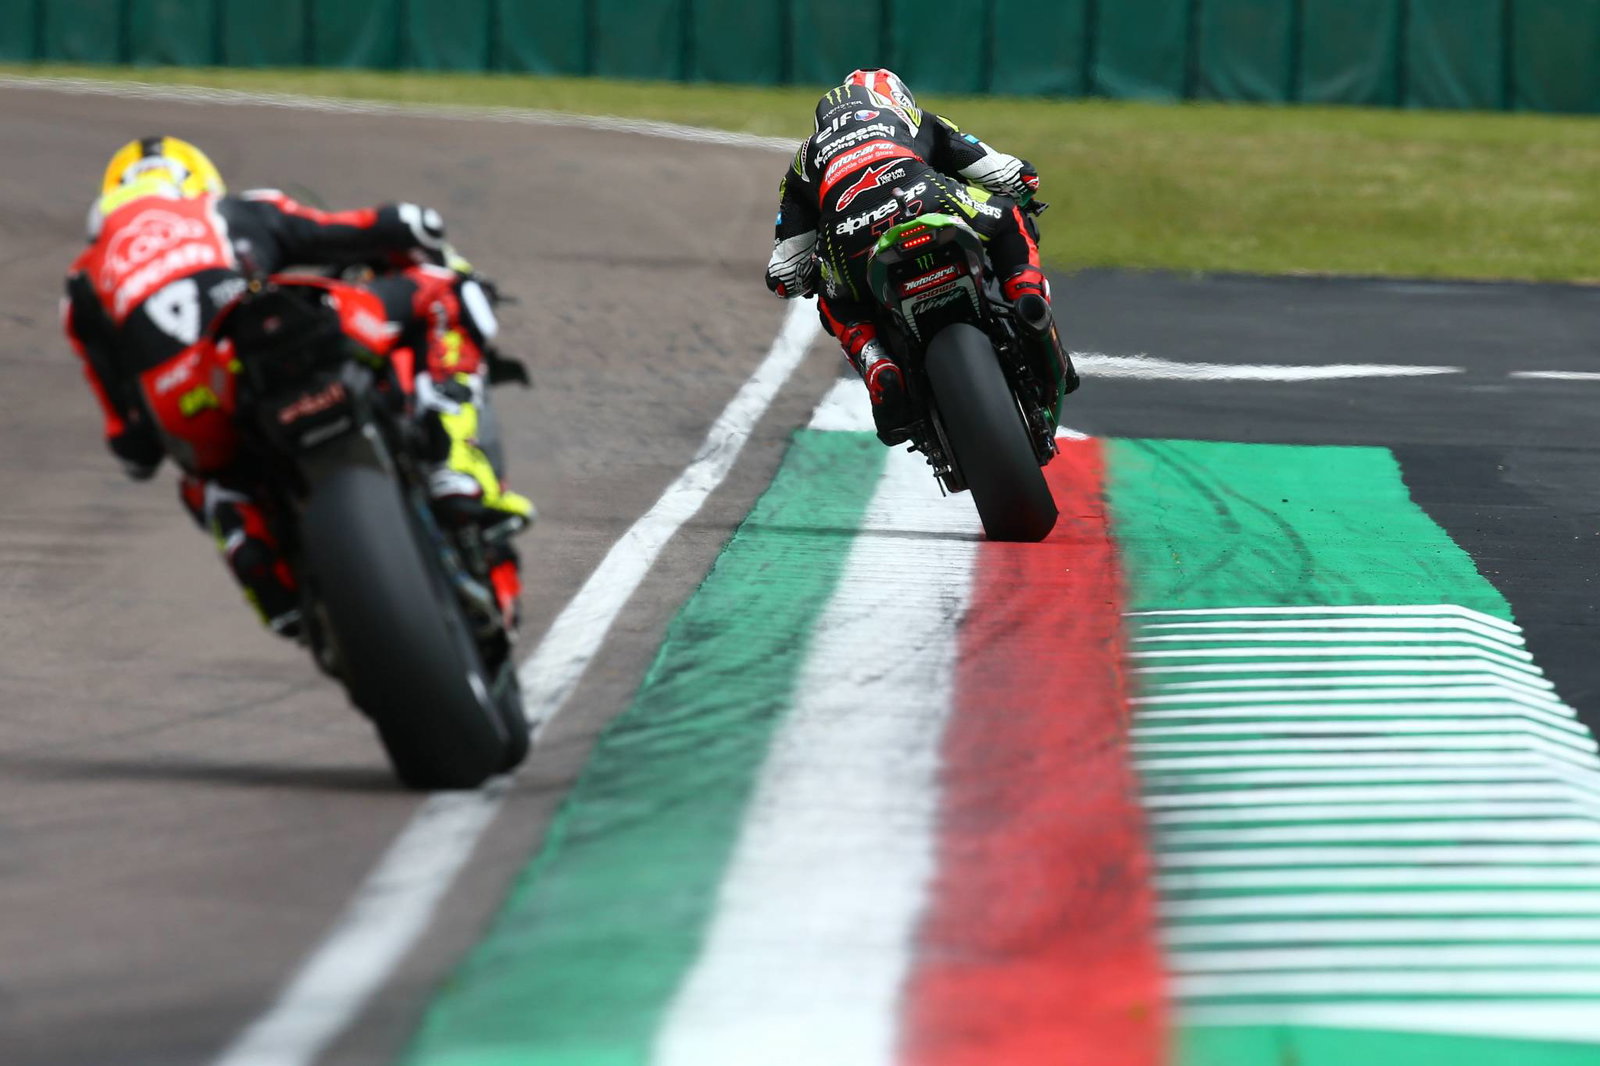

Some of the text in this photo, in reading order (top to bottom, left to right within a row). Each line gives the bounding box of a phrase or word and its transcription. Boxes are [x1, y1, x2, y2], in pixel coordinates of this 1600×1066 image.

[816, 111, 852, 143] elf
[814, 122, 895, 169] Kawasaki
[822, 139, 856, 164] Racing
[855, 131, 887, 142] Team
[827, 162, 857, 185] Motorcycle
[857, 154, 875, 164] Gear
[904, 265, 956, 291] Motocard
